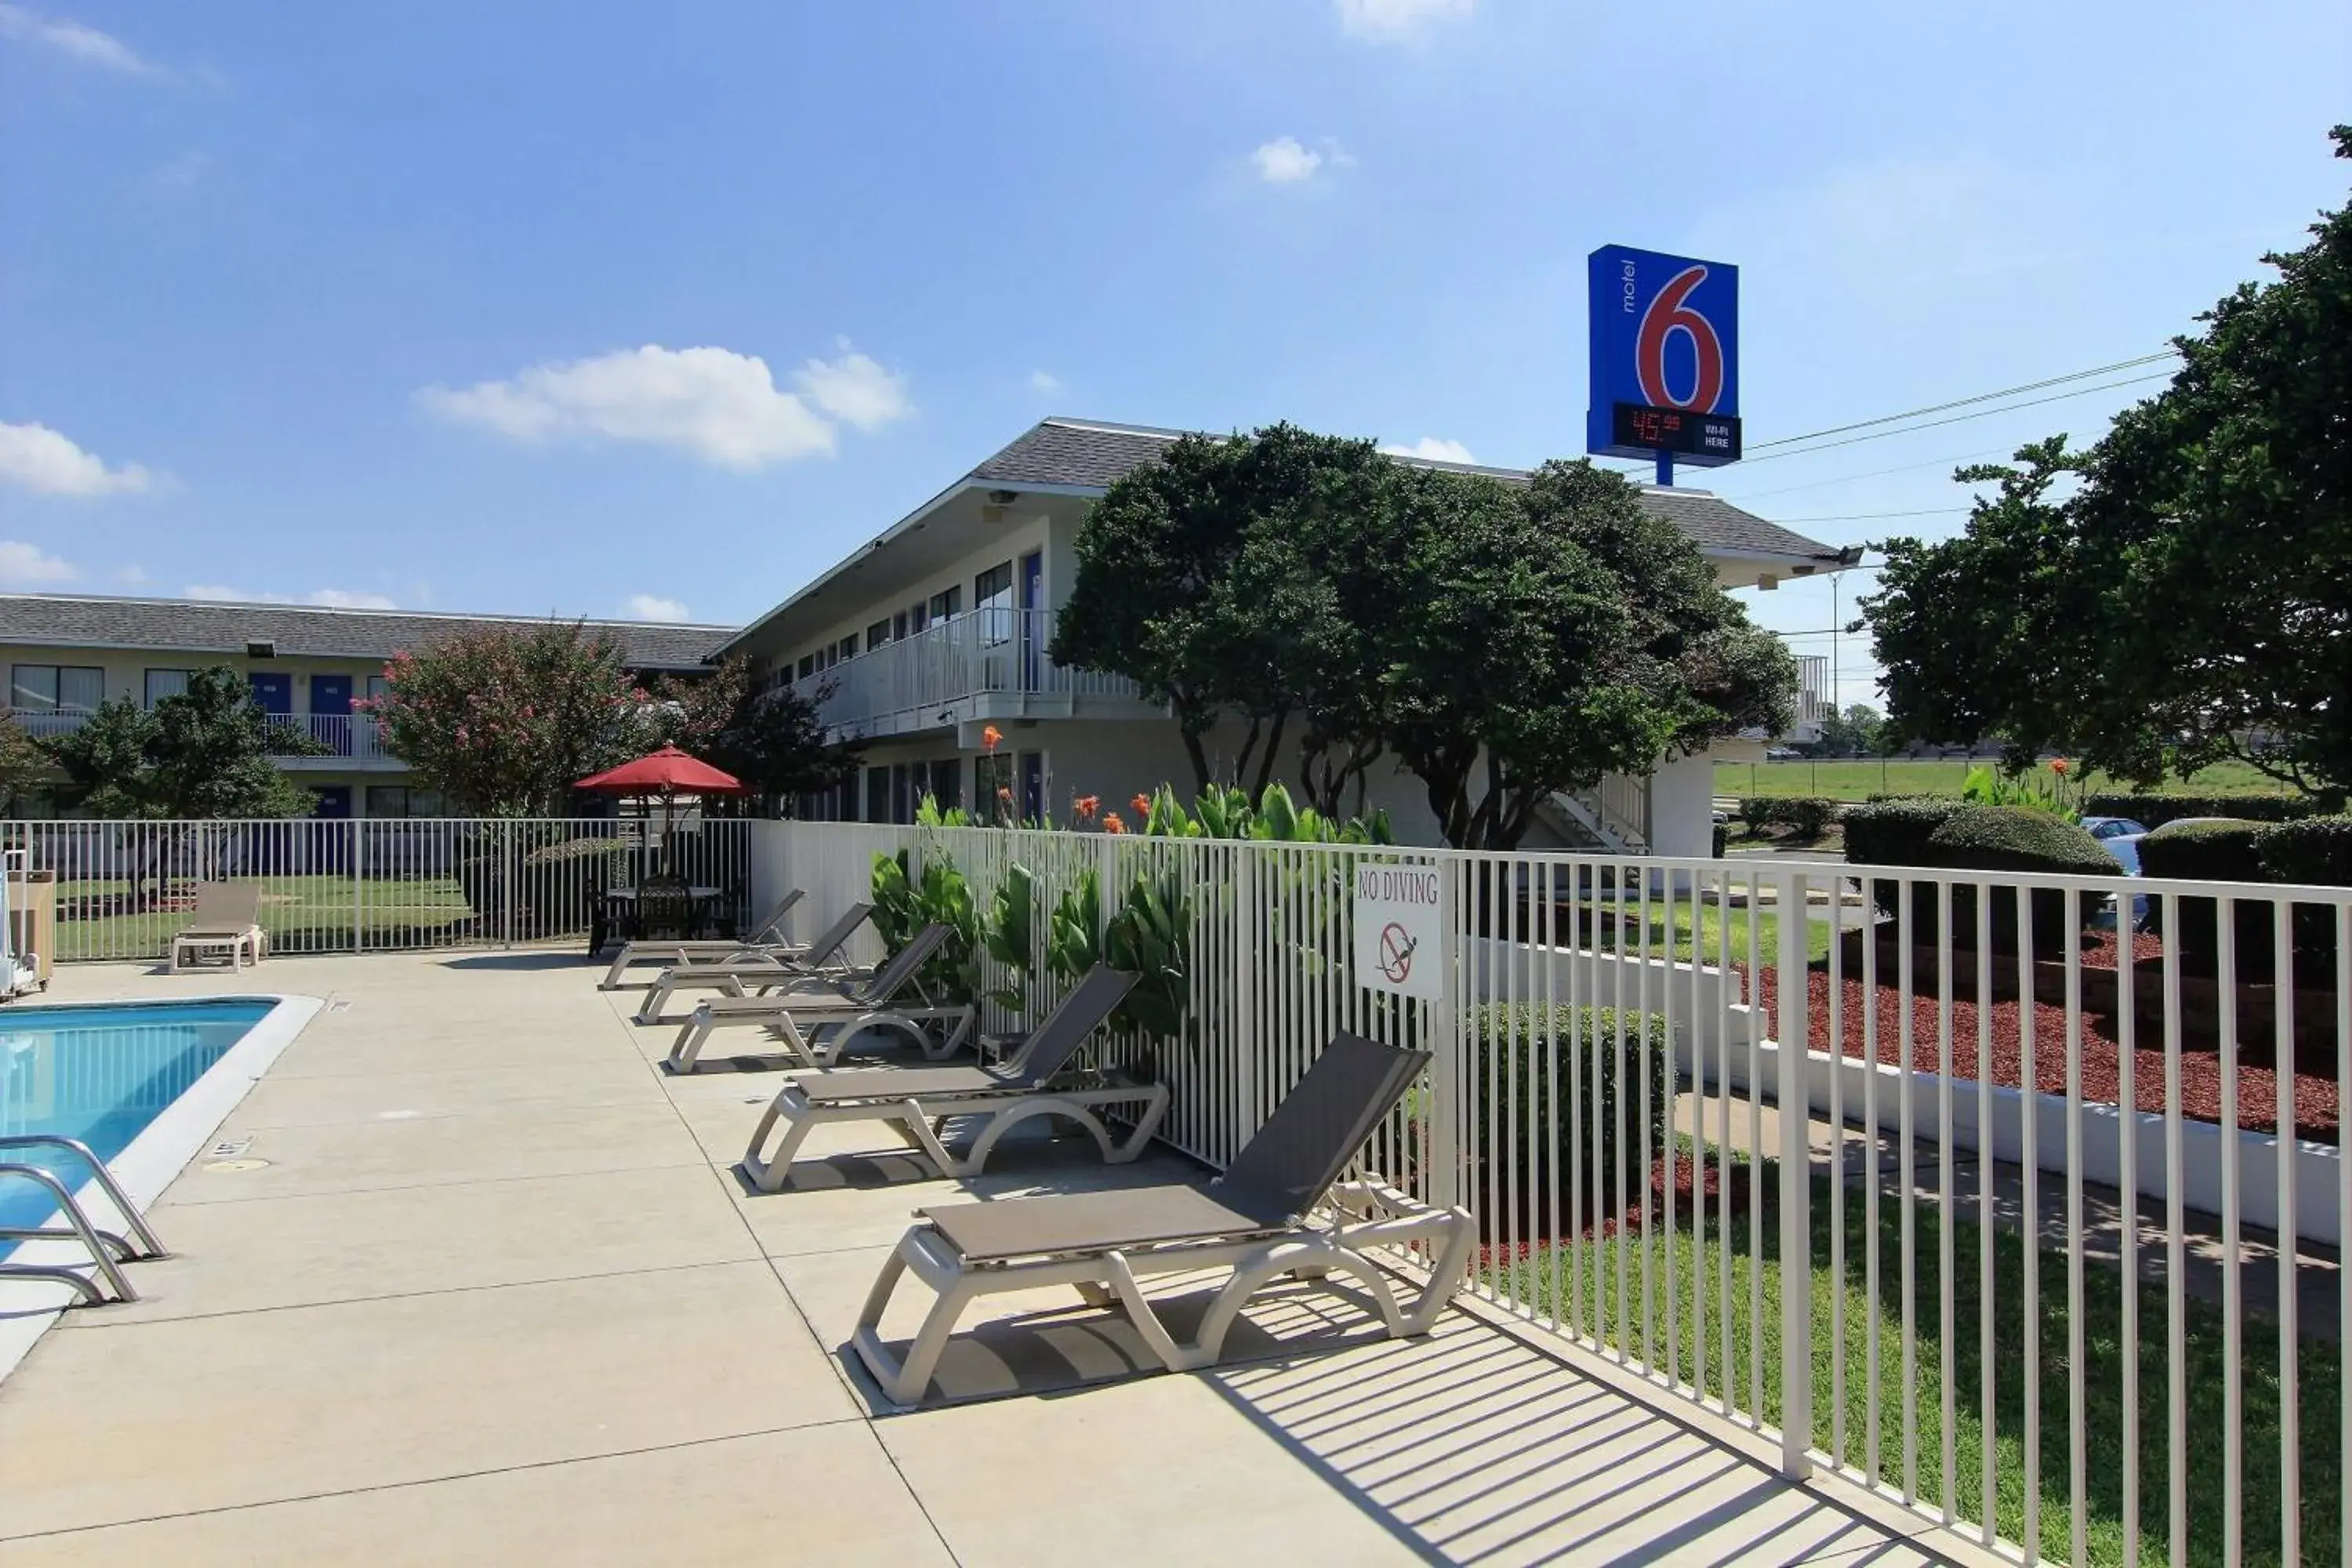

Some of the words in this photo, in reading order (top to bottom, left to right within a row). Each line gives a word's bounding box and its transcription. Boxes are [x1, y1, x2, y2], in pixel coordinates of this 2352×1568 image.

[1621, 260, 1635, 313] motel
[1635, 264, 1724, 415] 6
[1705, 437, 1729, 448] HERE
[1358, 870, 1377, 900] NO
[1384, 872, 1438, 904] DIVING
